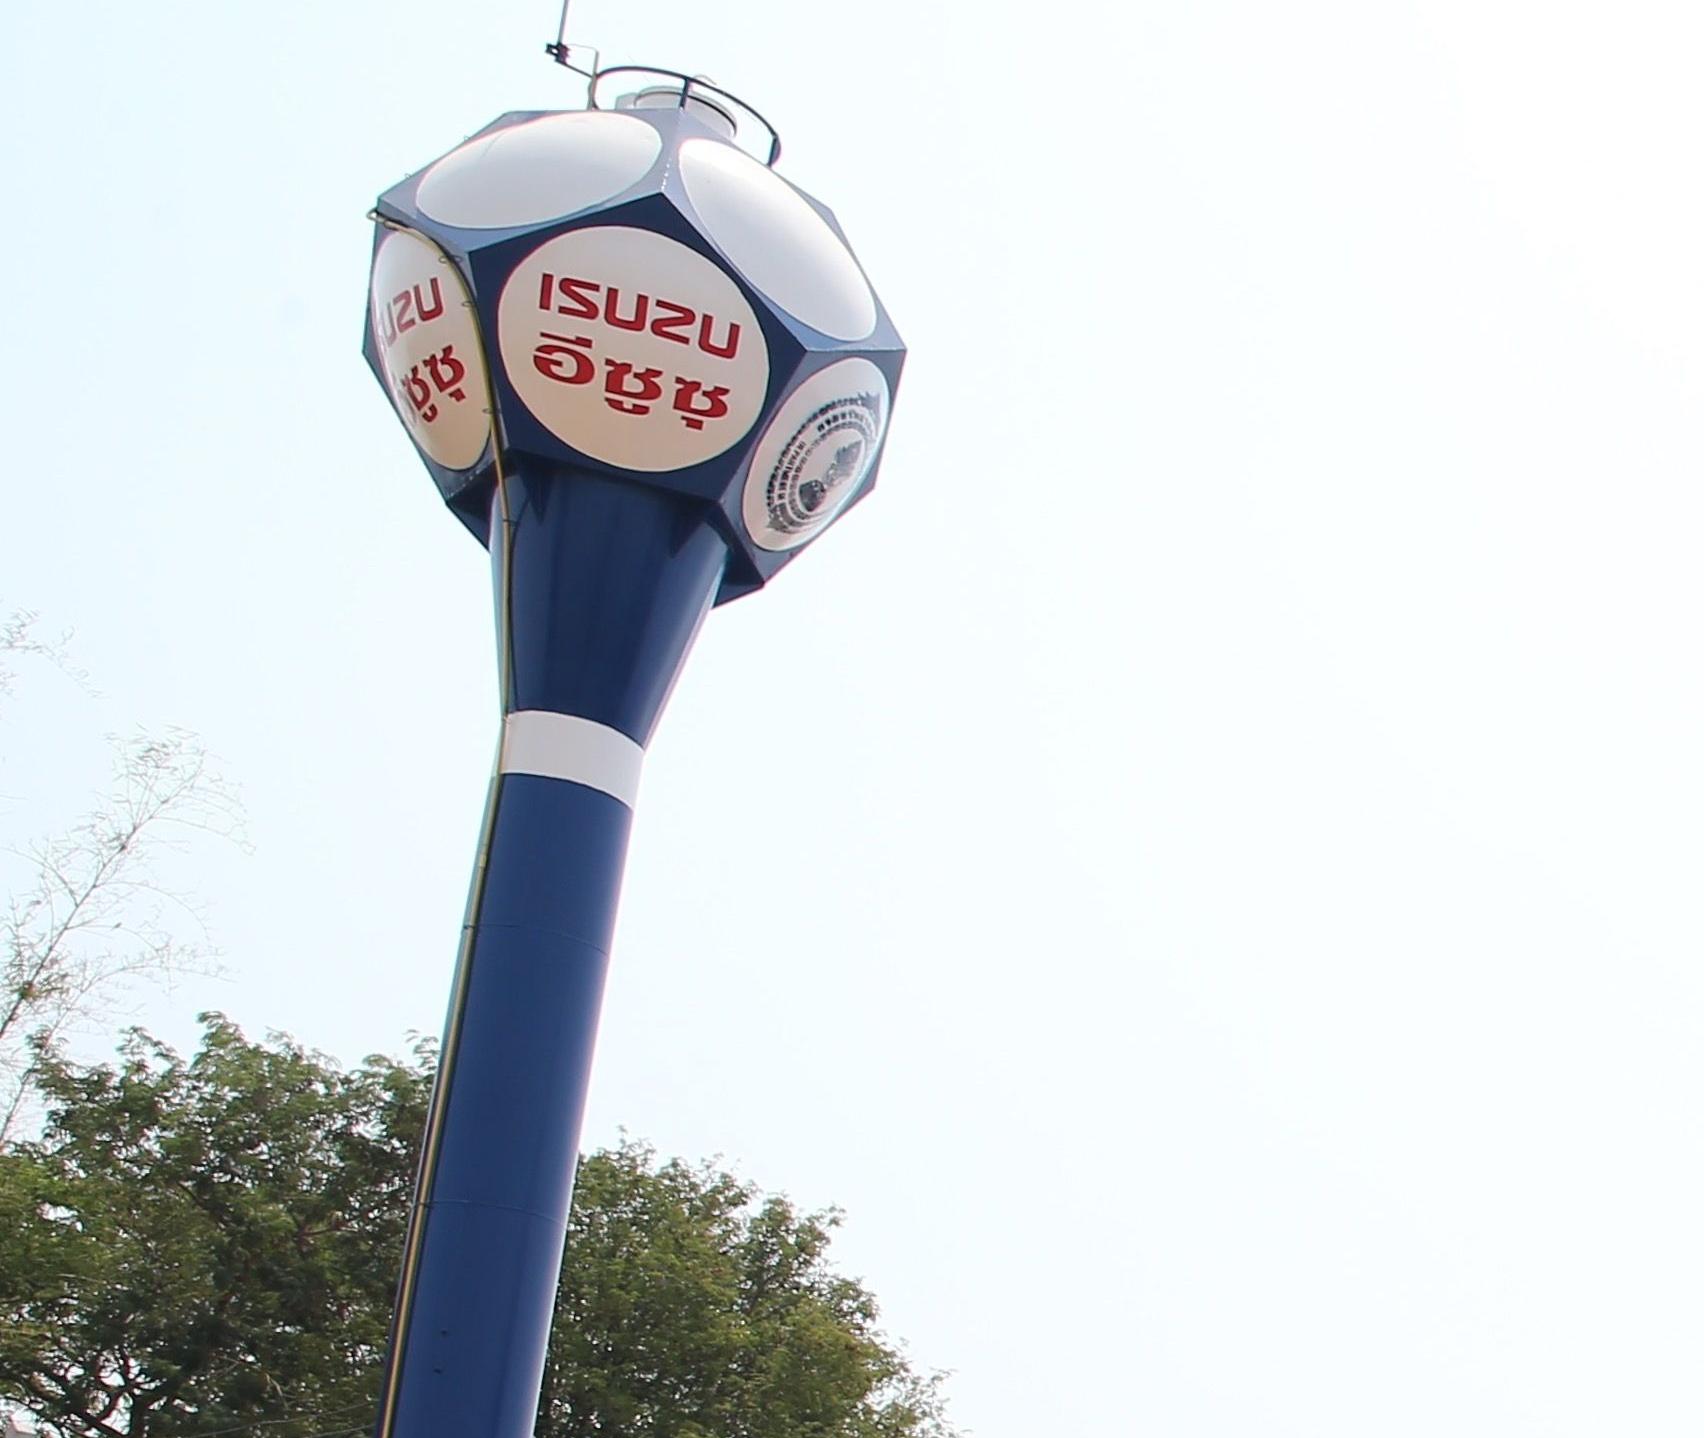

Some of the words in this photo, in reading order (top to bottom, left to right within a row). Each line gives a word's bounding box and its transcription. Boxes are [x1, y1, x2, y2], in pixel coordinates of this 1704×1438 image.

[539, 273, 741, 360] ISUZU
[533, 332, 731, 431] อีซูซุ
